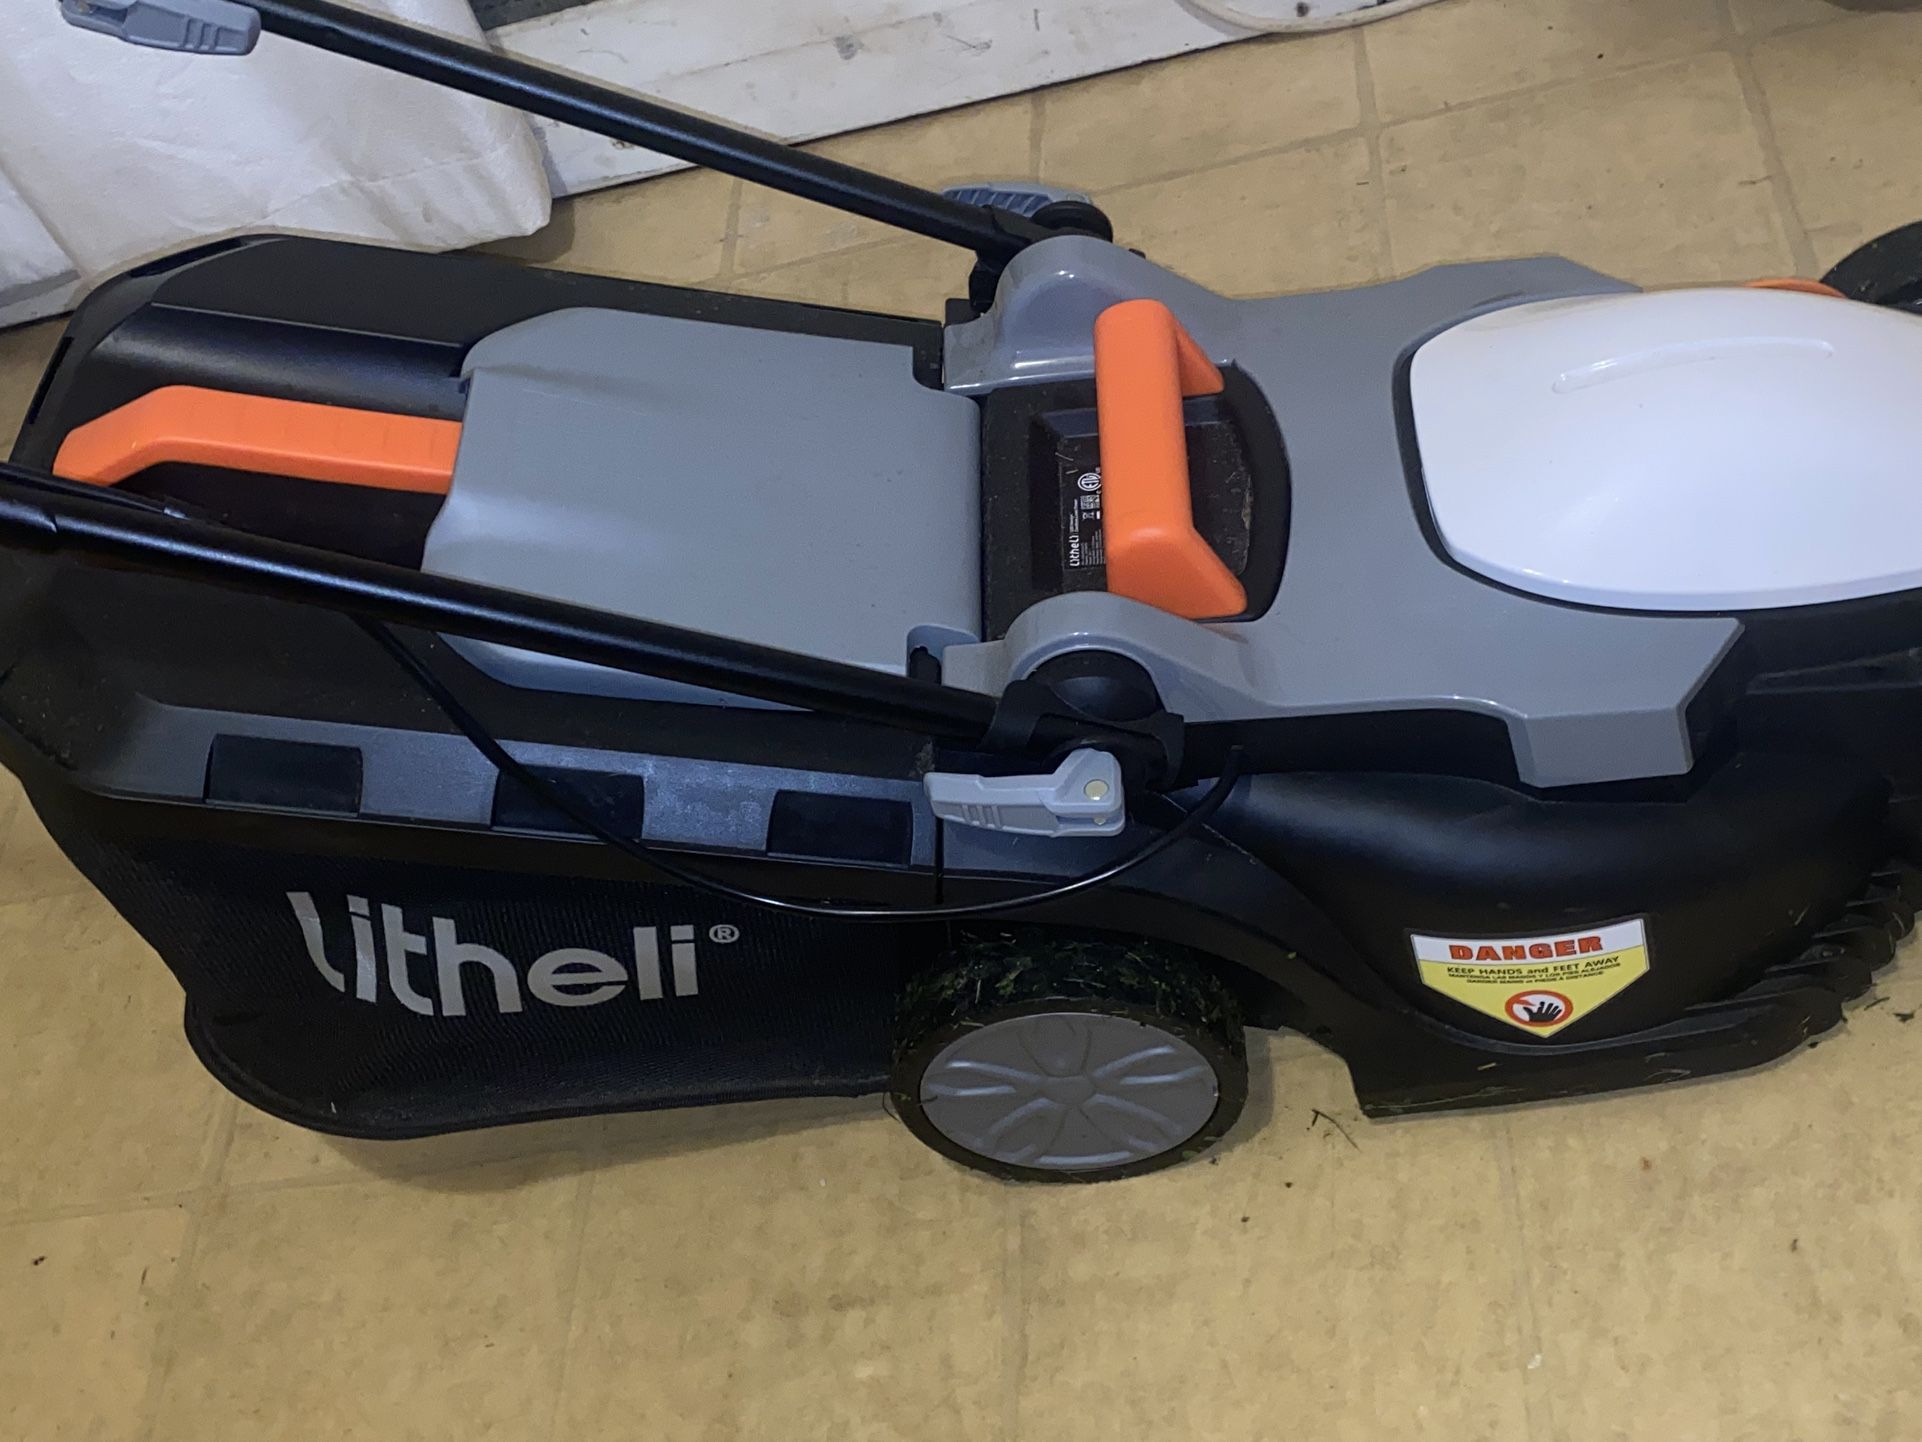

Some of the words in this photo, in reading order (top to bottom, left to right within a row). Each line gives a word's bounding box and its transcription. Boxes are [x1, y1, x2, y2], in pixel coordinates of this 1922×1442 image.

[1448, 935, 1604, 961] DANGER
[1446, 966, 1475, 975] KEEP
[1479, 967, 1523, 976] HANDS
[1526, 966, 1549, 975] and
[1553, 962, 1580, 972] FEET
[1584, 955, 1620, 969] AWAY
